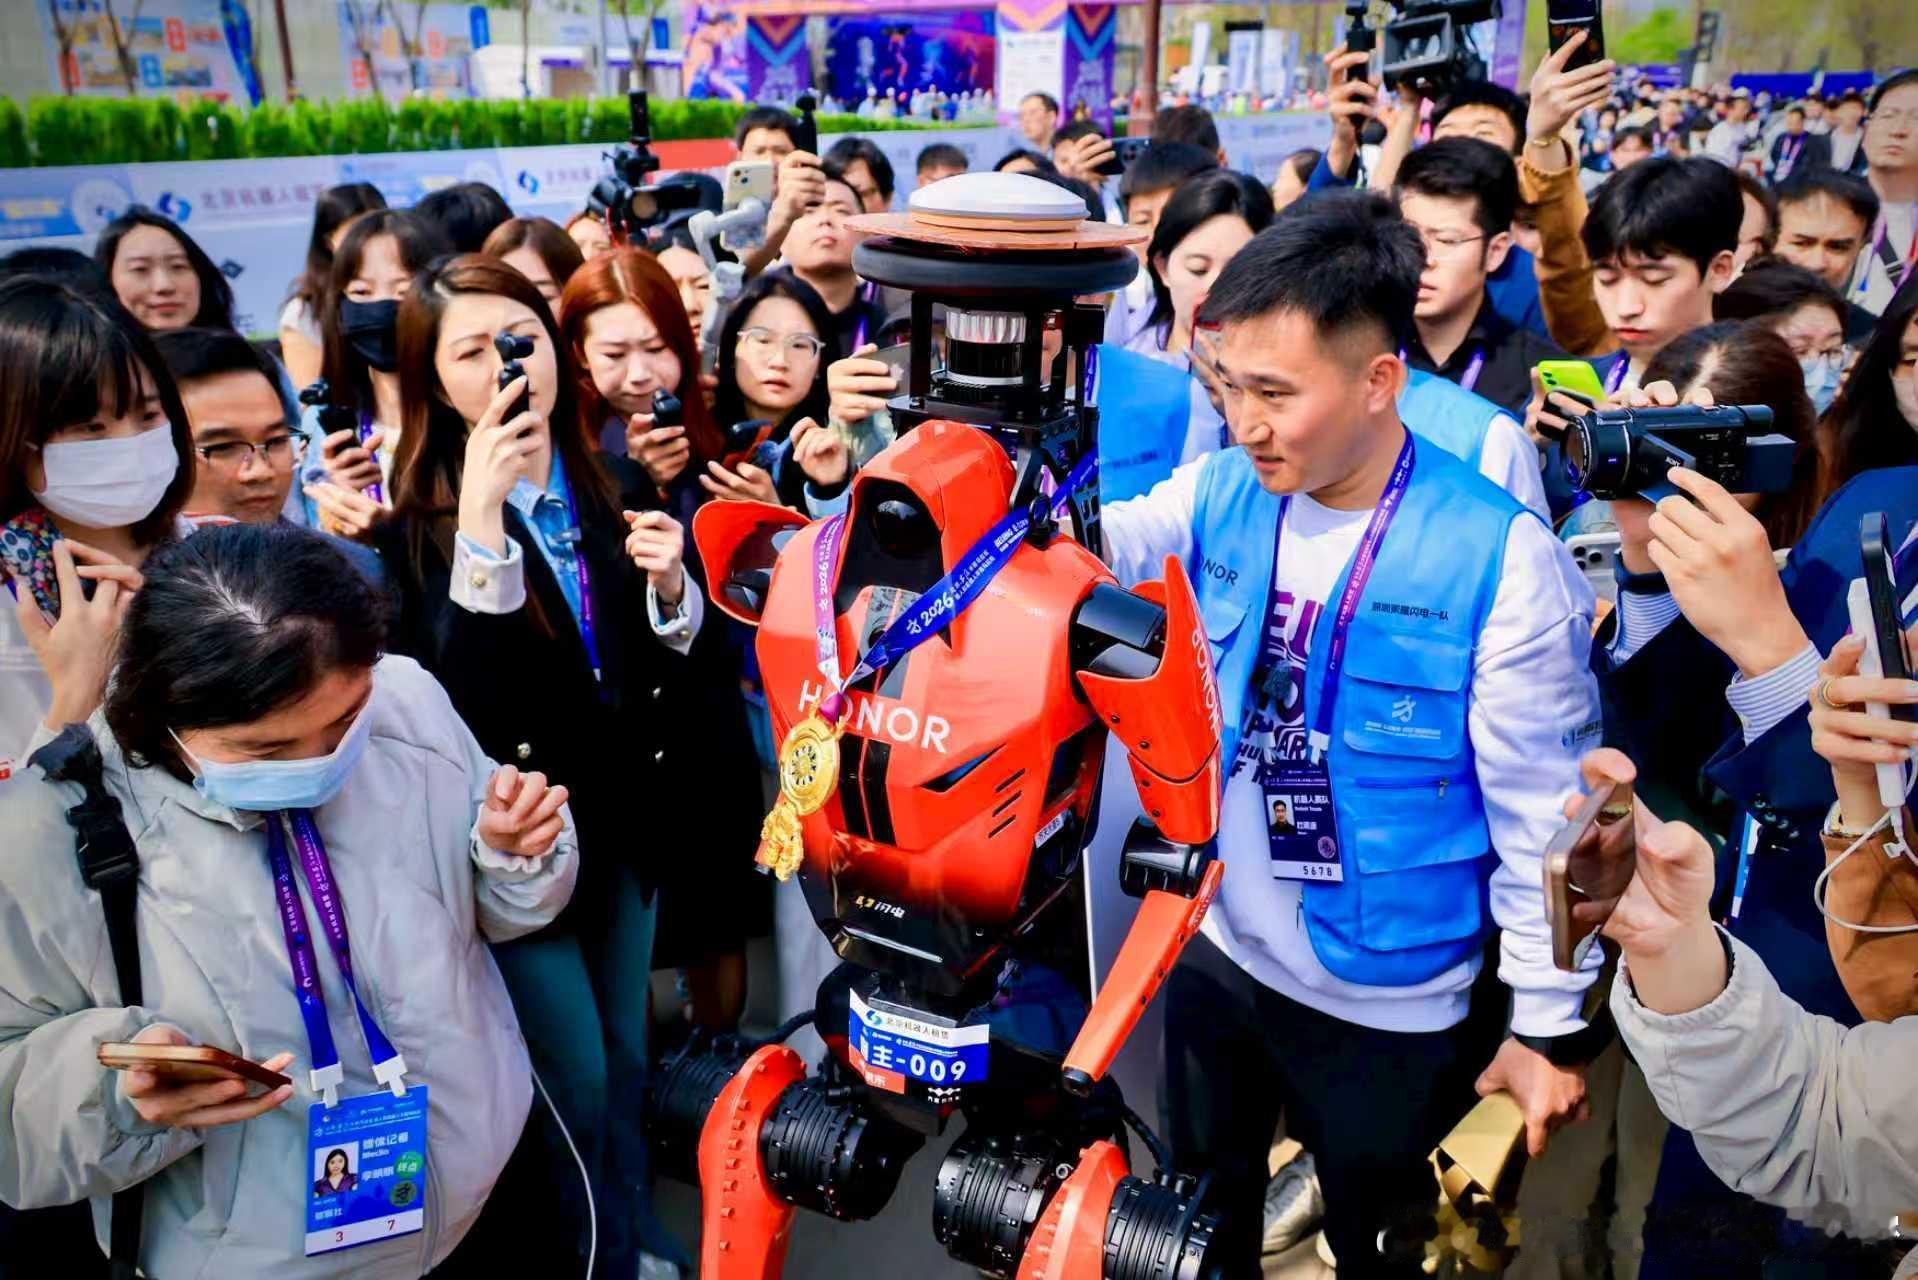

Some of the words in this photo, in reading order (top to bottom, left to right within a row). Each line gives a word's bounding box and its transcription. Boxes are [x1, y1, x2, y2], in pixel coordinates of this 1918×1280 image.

[920, 591, 954, 627] 2026
[335, 1231, 344, 1242] 3
[387, 1219, 396, 1231] 7
